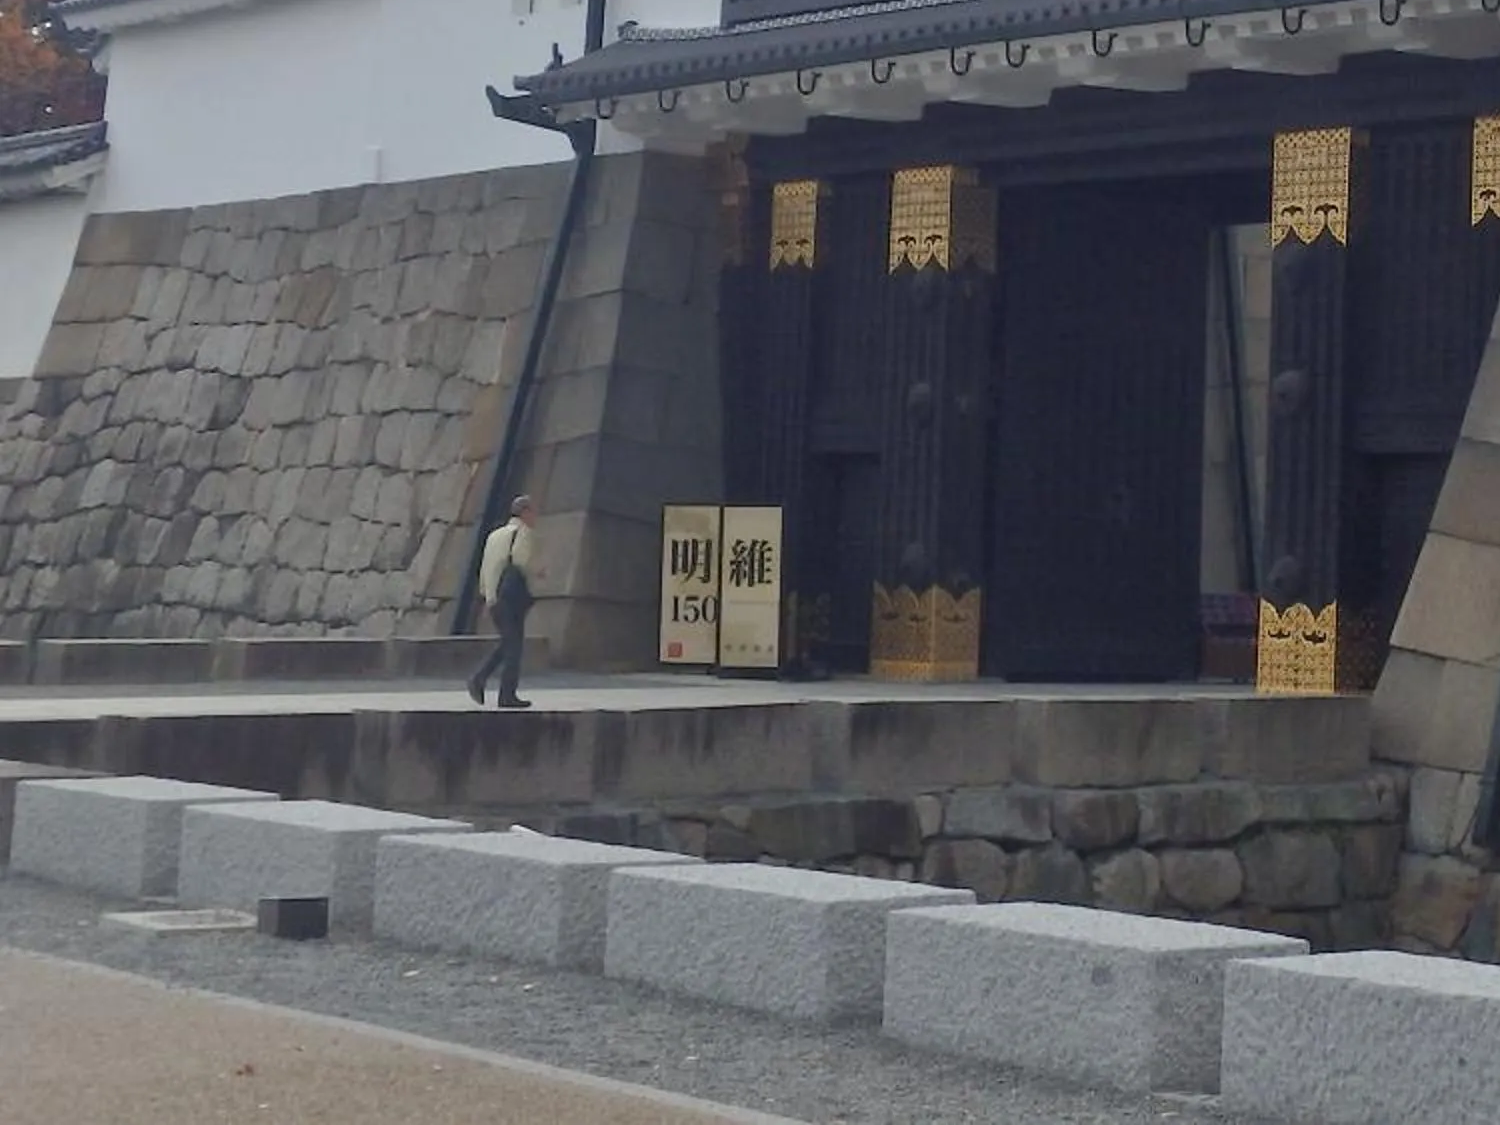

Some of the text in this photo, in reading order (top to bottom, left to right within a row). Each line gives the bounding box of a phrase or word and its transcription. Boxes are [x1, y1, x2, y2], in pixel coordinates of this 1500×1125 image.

[671, 539, 712, 584] 明
[729, 539, 773, 588] 維
[671, 594, 718, 623] 150
